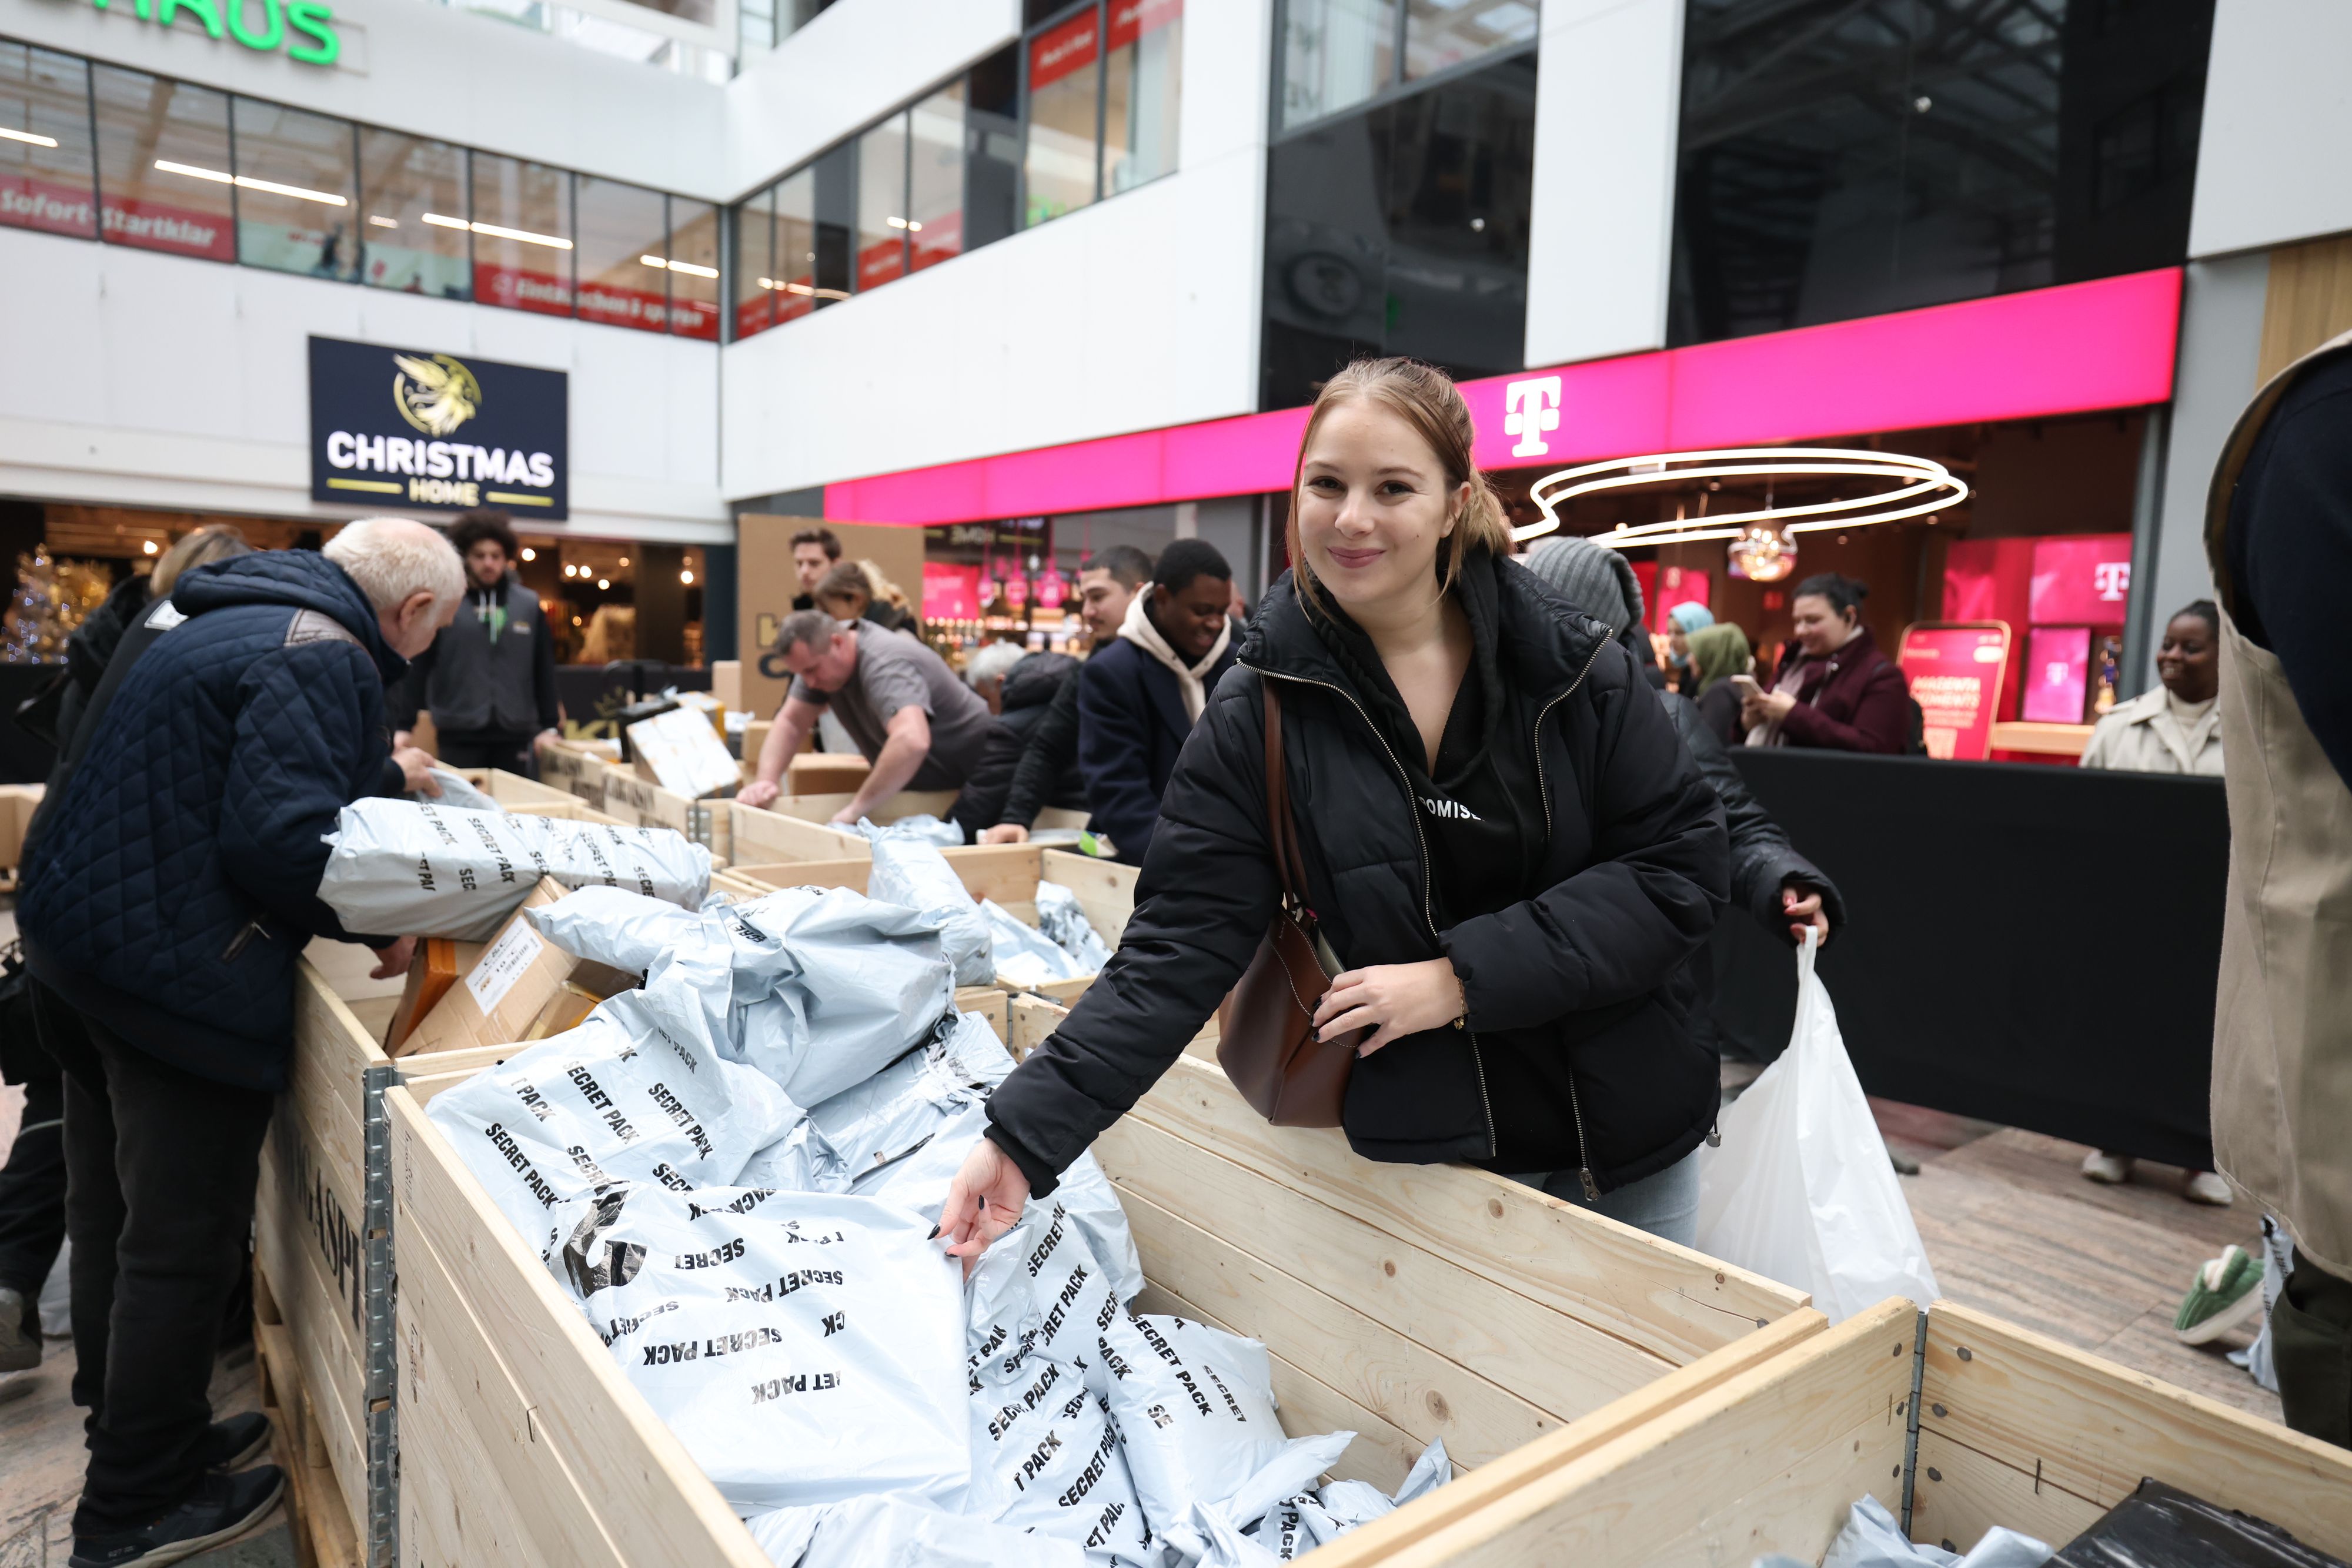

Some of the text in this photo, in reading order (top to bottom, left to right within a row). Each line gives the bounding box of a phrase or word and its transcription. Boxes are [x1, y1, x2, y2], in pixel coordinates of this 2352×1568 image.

[2, 188, 216, 248] Sofort Startklar
[1504, 376, 1562, 457] T
[327, 430, 554, 488] CHRISTMAS
[409, 477, 479, 507] HOME
[430, 820, 458, 845] PACK
[468, 817, 516, 883] SECRET PACK
[579, 831, 609, 868] SECRET
[516, 1082, 557, 1122] PACK
[563, 1061, 613, 1110] SECRET
[603, 1109, 640, 1145] PACK
[648, 1082, 694, 1128] SECRET
[685, 1124, 714, 1161] PACK
[485, 1123, 559, 1211] SECRET PACK
[674, 1238, 745, 1270] SECRET
[1027, 1221, 1064, 1278] SECRET
[724, 1269, 843, 1303] SECRET PACK
[1060, 1263, 1088, 1308] PACK
[610, 1300, 679, 1340] SECRET
[643, 1327, 783, 1365] SECRET PACK
[1127, 1315, 1214, 1417] SECRET PACK
[751, 1375, 807, 1405] PACK
[1023, 1363, 1060, 1410] PACK
[1201, 1365, 1247, 1422] SECRET
[1022, 1429, 1063, 1481] PACK
[1058, 1449, 1106, 1507] SECRET
[1279, 1512, 1299, 1563] PACK
